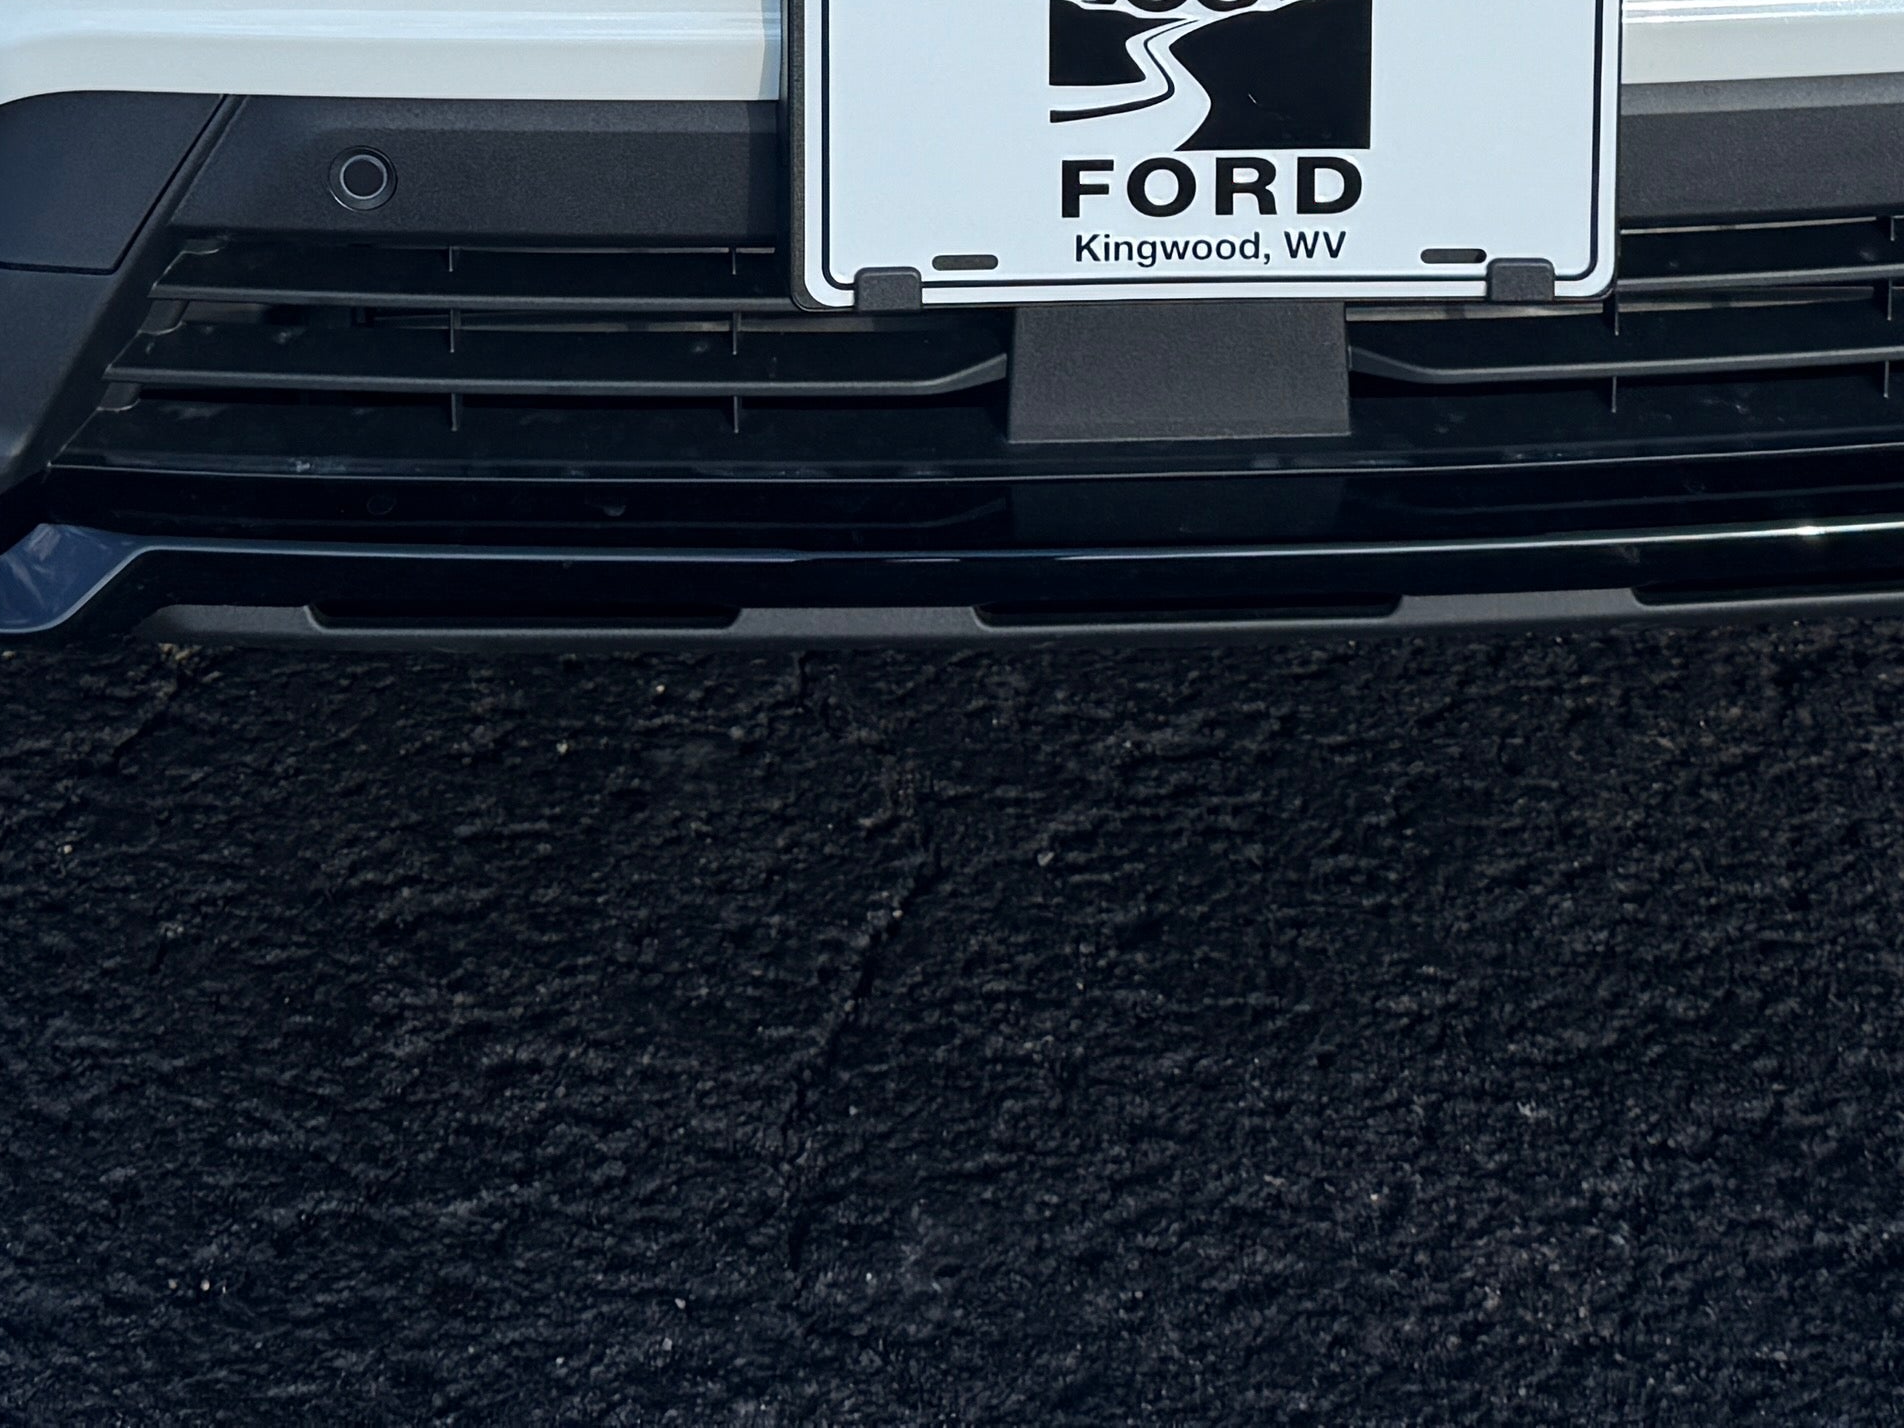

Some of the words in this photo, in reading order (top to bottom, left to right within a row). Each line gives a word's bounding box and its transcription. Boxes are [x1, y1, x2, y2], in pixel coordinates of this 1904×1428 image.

[1061, 156, 1363, 219] FORD
[1075, 231, 1273, 268] Kingwood,
[1284, 230, 1346, 260] WV
